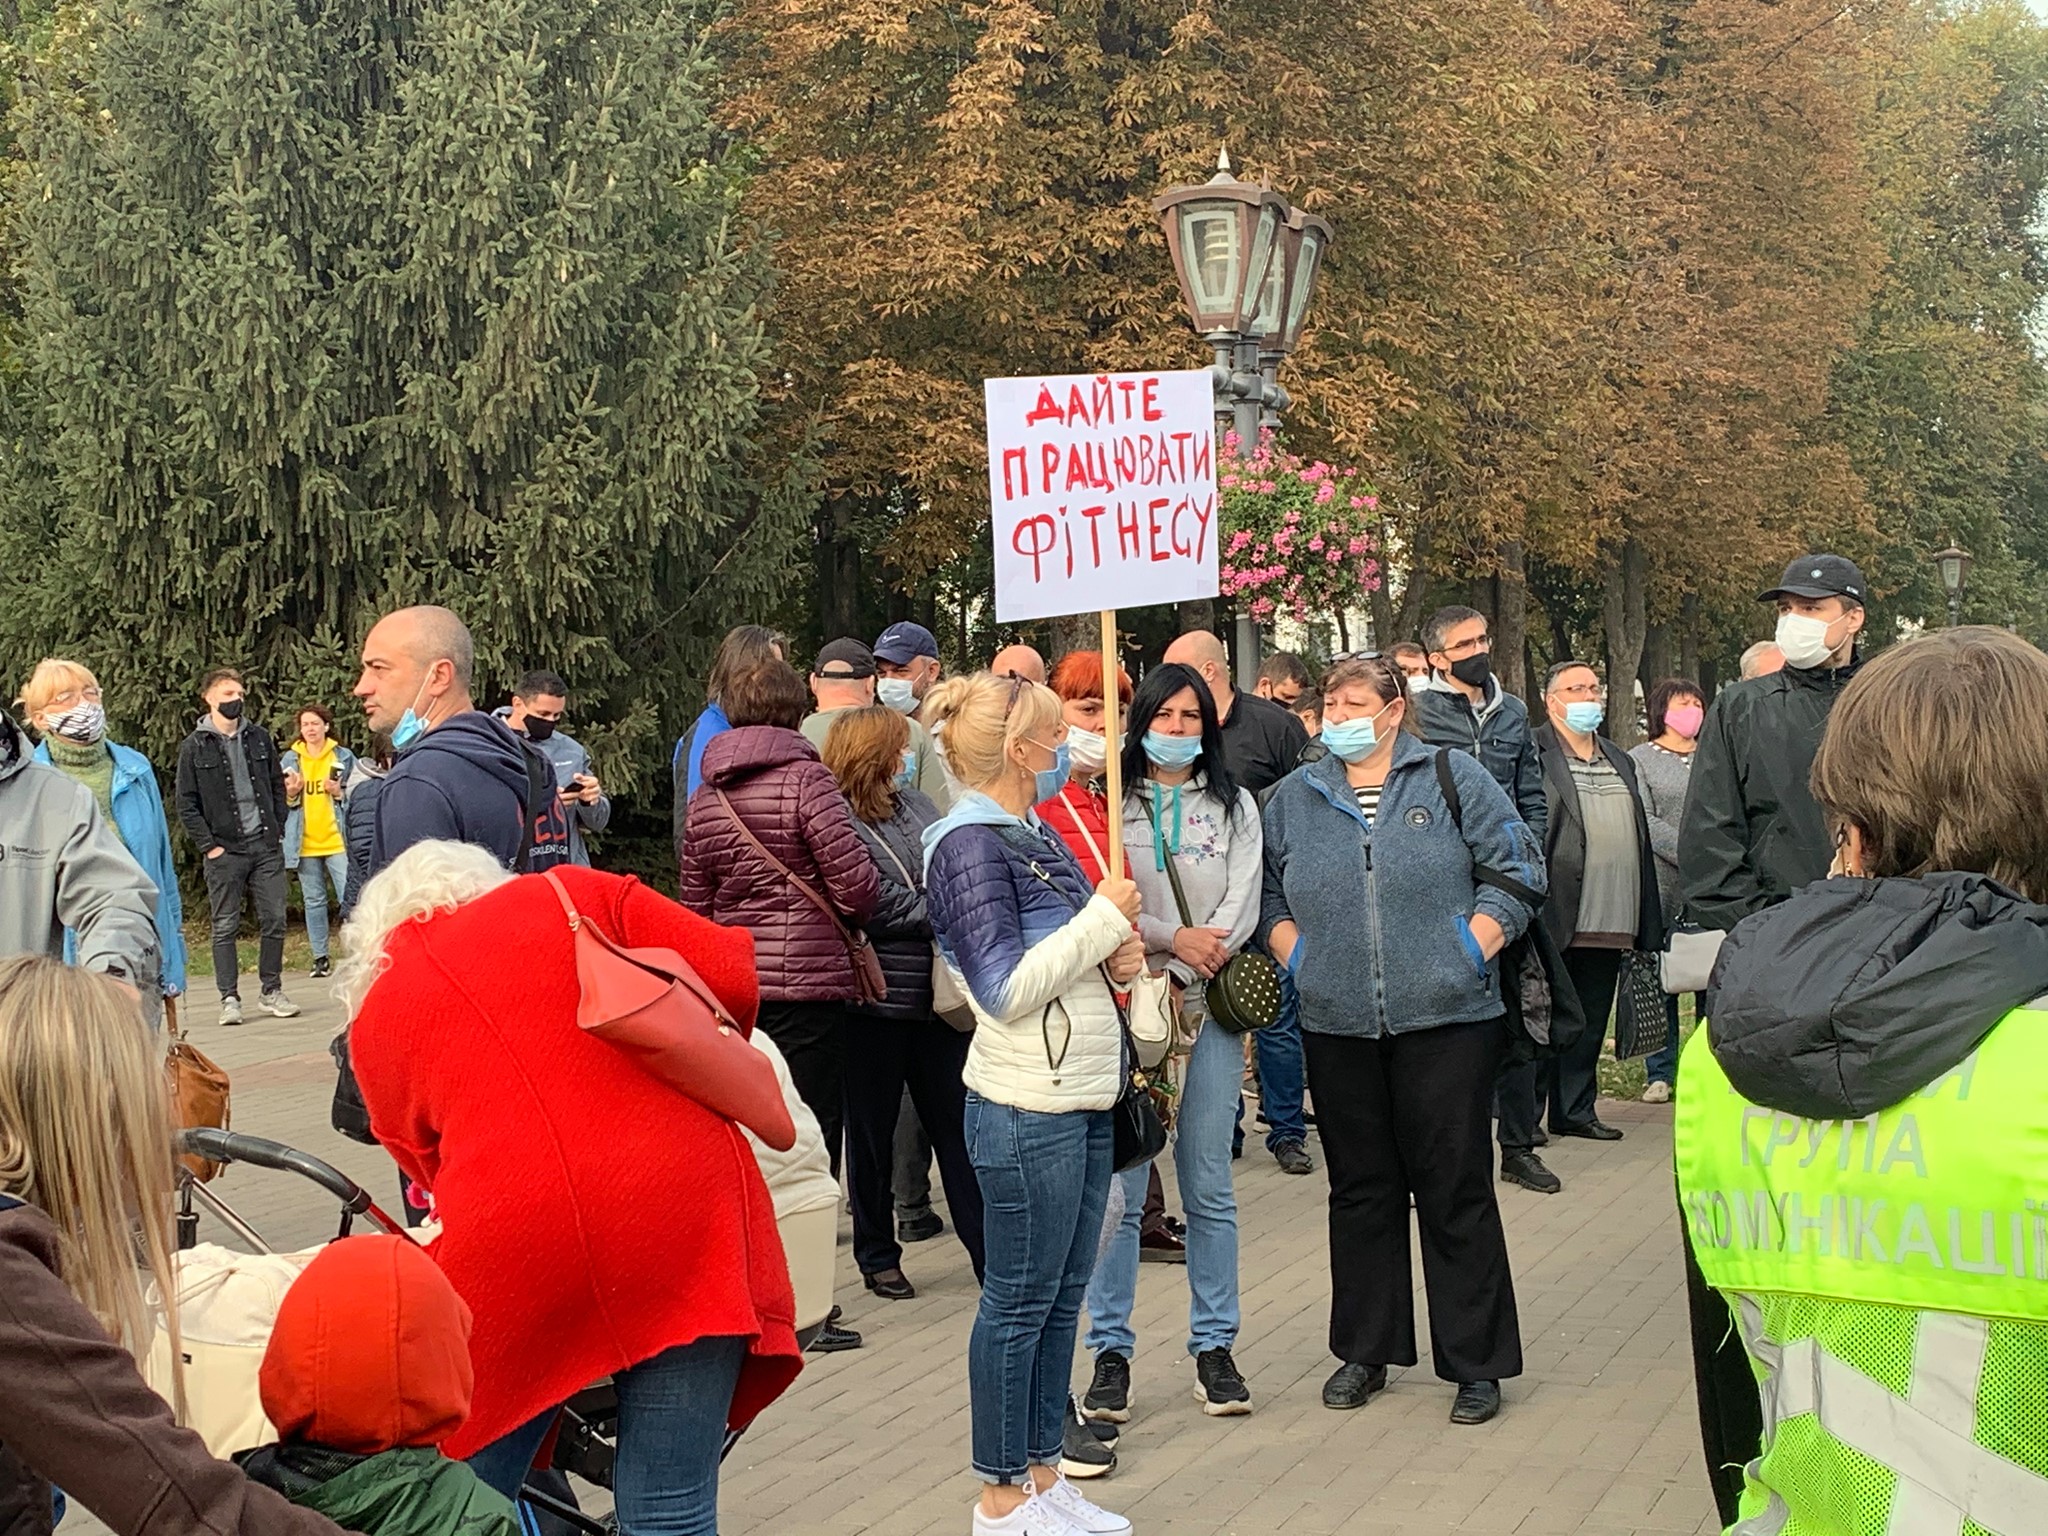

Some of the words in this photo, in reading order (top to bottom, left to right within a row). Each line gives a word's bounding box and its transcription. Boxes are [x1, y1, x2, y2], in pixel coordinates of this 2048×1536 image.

[1025, 375, 1167, 429] ДАЙТЕ
[1003, 430, 1211, 500] ПРАЦЮВАТИ
[1741, 1106, 1927, 1178] ГРУПА
